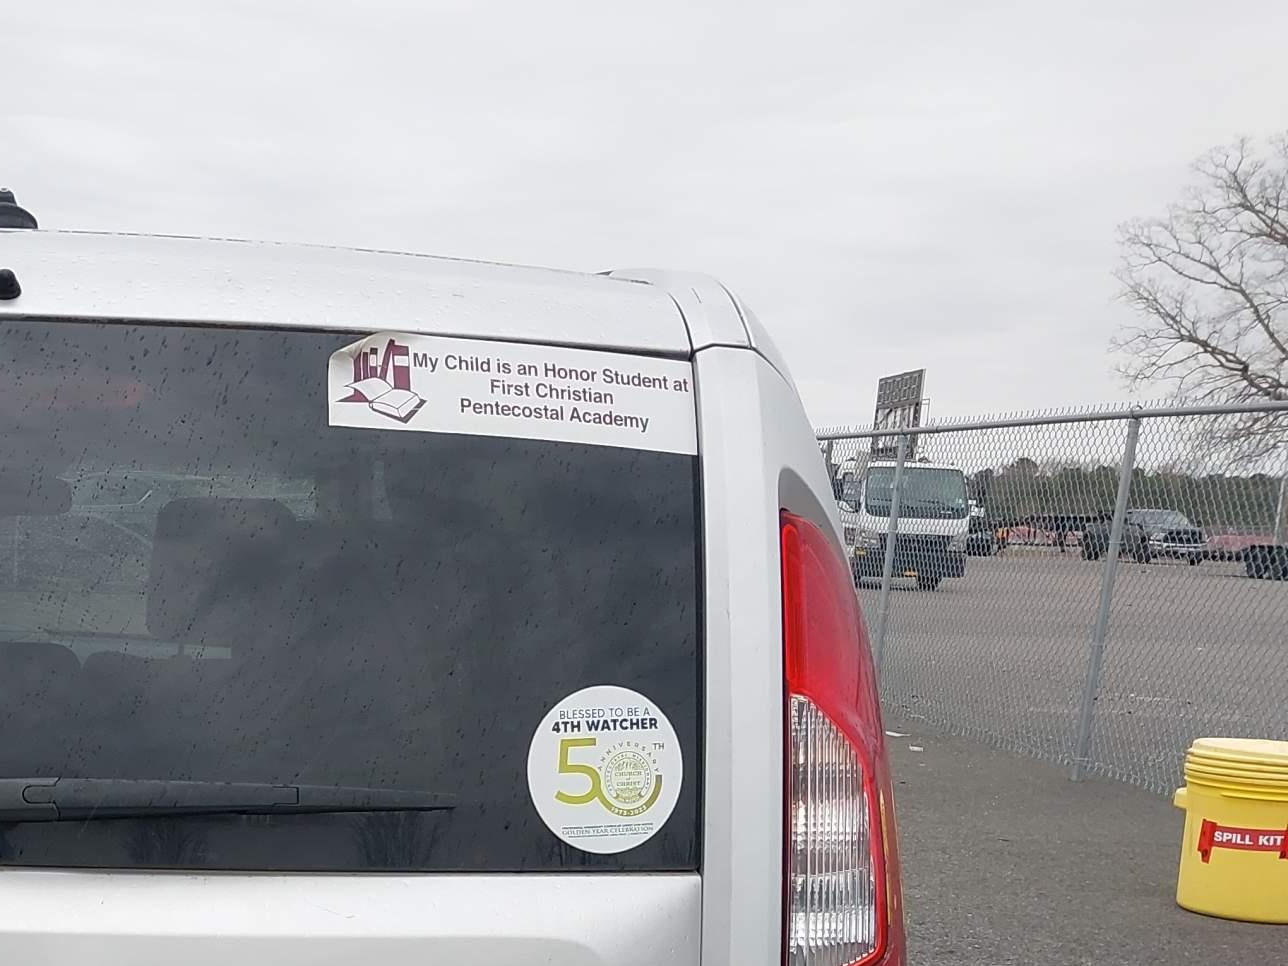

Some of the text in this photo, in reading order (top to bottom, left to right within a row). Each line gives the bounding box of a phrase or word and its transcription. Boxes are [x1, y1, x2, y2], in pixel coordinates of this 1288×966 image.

[413, 353, 689, 393] My Child is an Honor Student at
[490, 379, 614, 404] First Christian
[460, 398, 649, 432] Pentecostal Academy
[559, 707, 651, 720] BLESSED TO BE A
[552, 718, 659, 734] 4TH WATCHER
[1214, 831, 1285, 846] SPILL KIT
